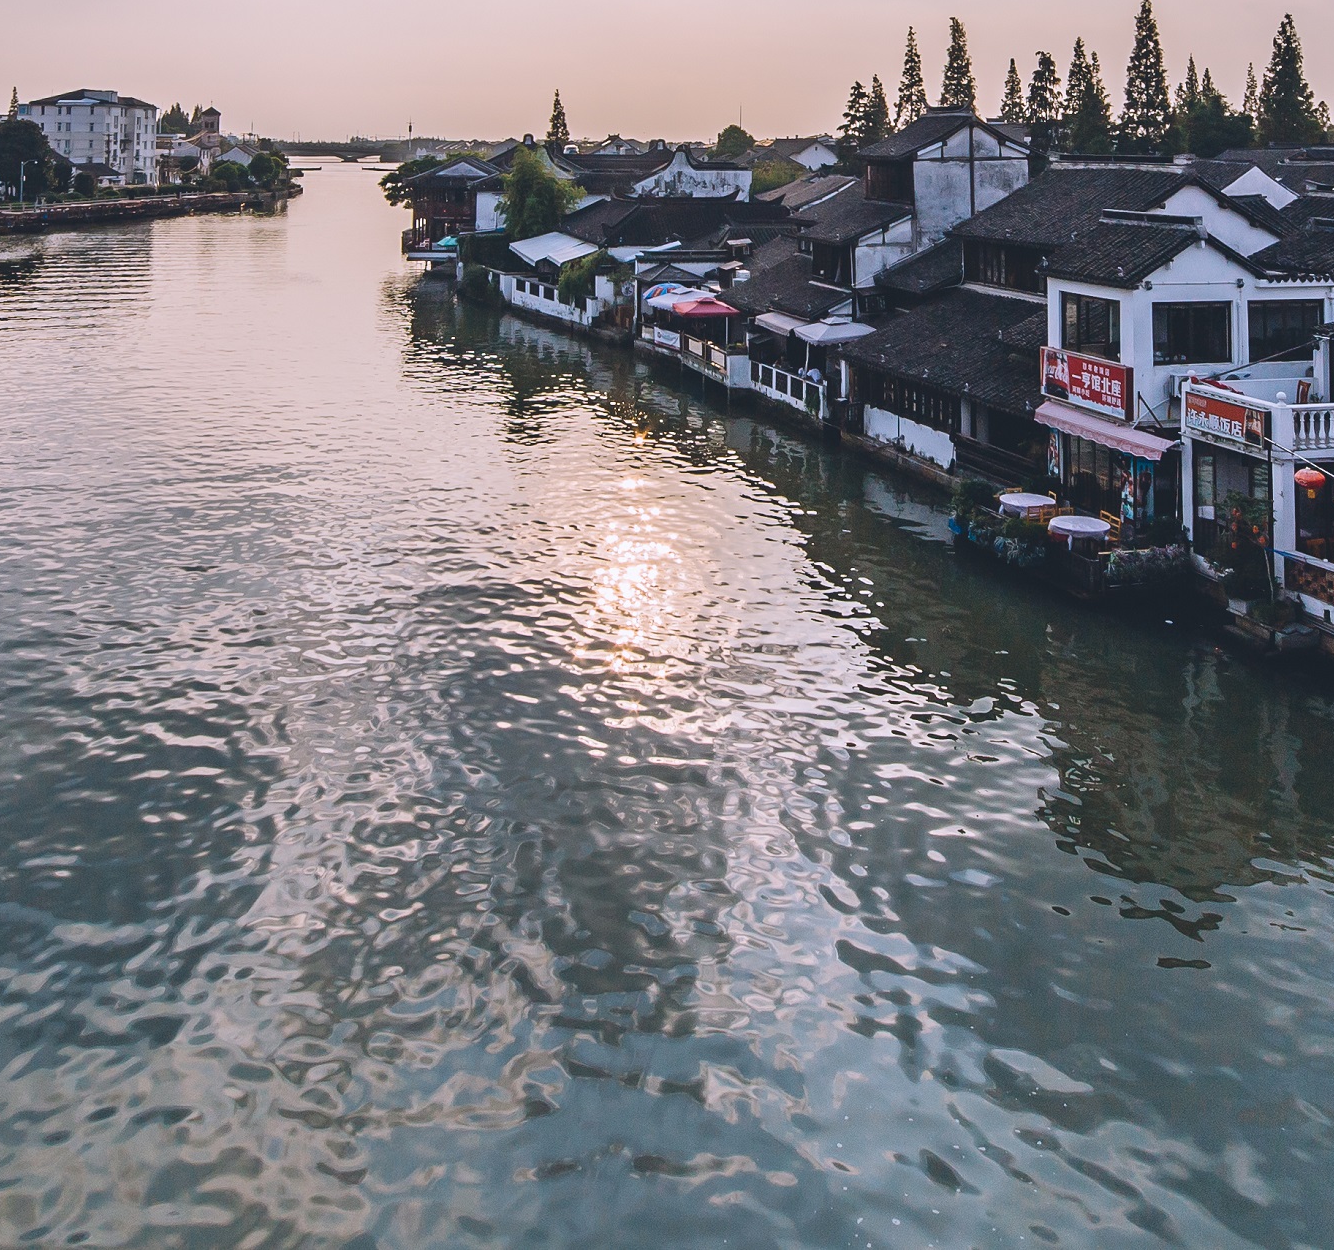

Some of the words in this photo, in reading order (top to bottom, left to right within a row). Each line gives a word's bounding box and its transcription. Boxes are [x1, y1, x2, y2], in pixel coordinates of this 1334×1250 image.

[1187, 407, 1243, 438] 许永顺饭店
